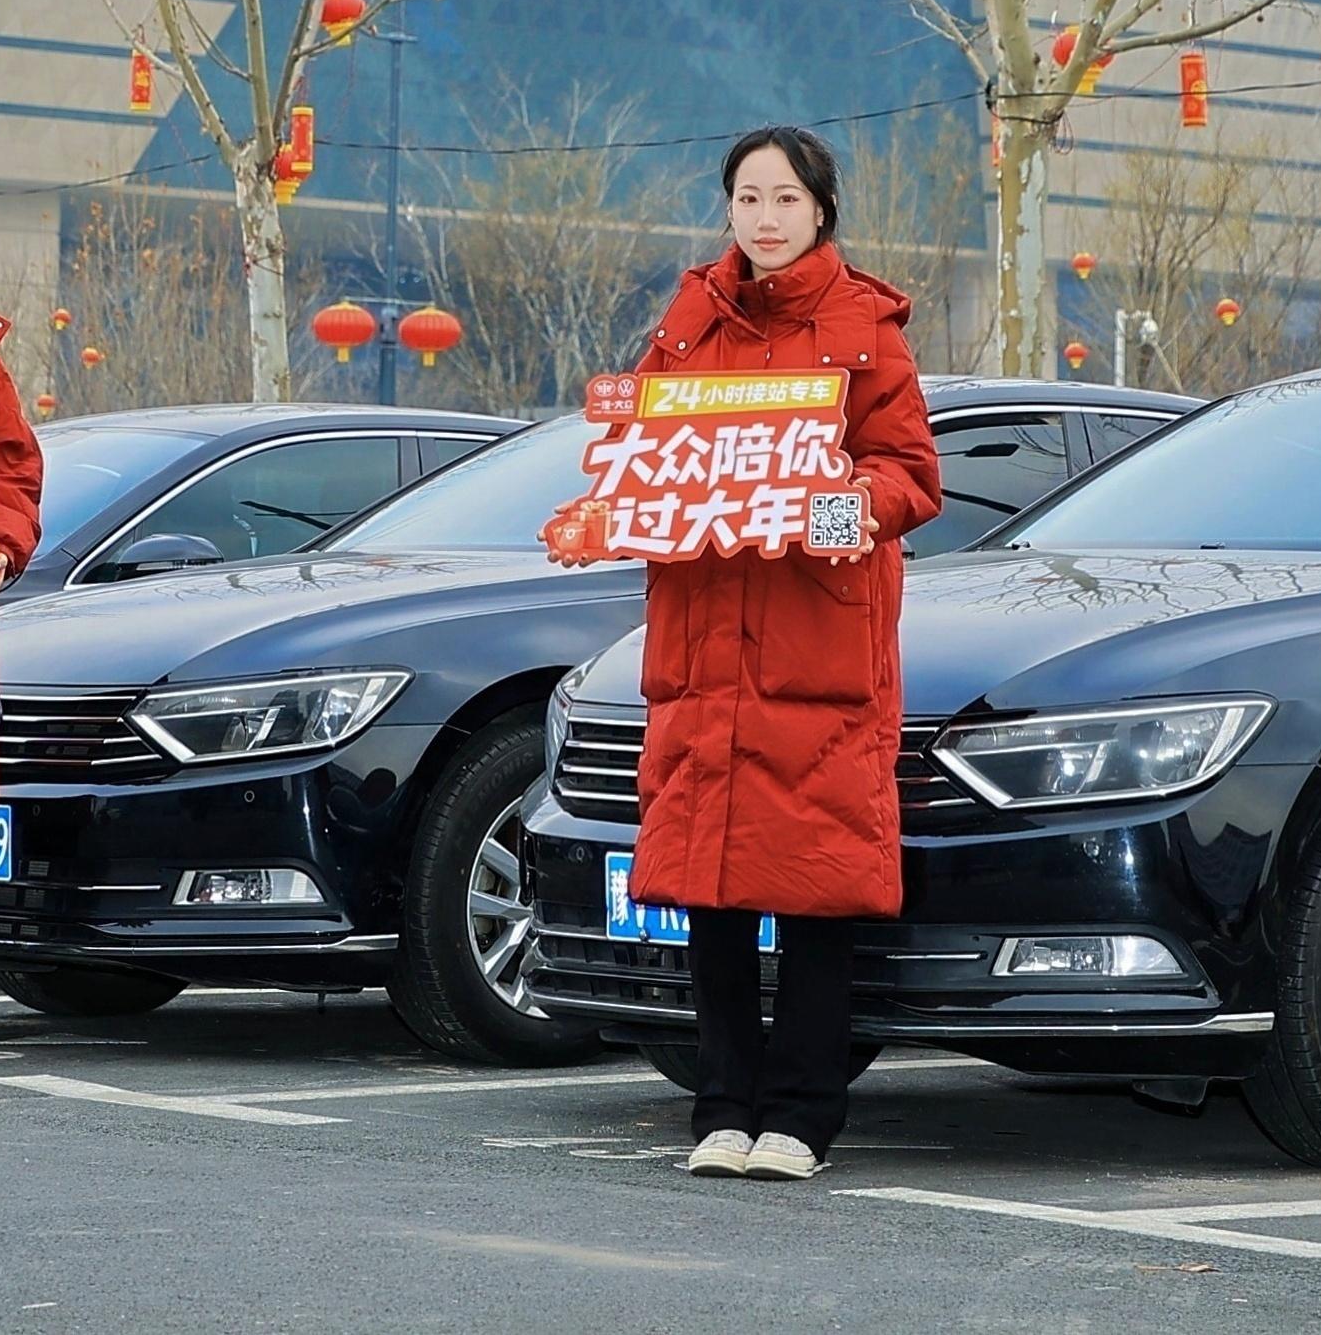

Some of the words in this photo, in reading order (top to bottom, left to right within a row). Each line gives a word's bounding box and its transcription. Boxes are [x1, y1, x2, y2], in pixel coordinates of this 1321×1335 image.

[653, 379, 832, 413] 24小时接站专车
[590, 417, 844, 498] 大众陪你
[607, 484, 808, 554] 过大年
